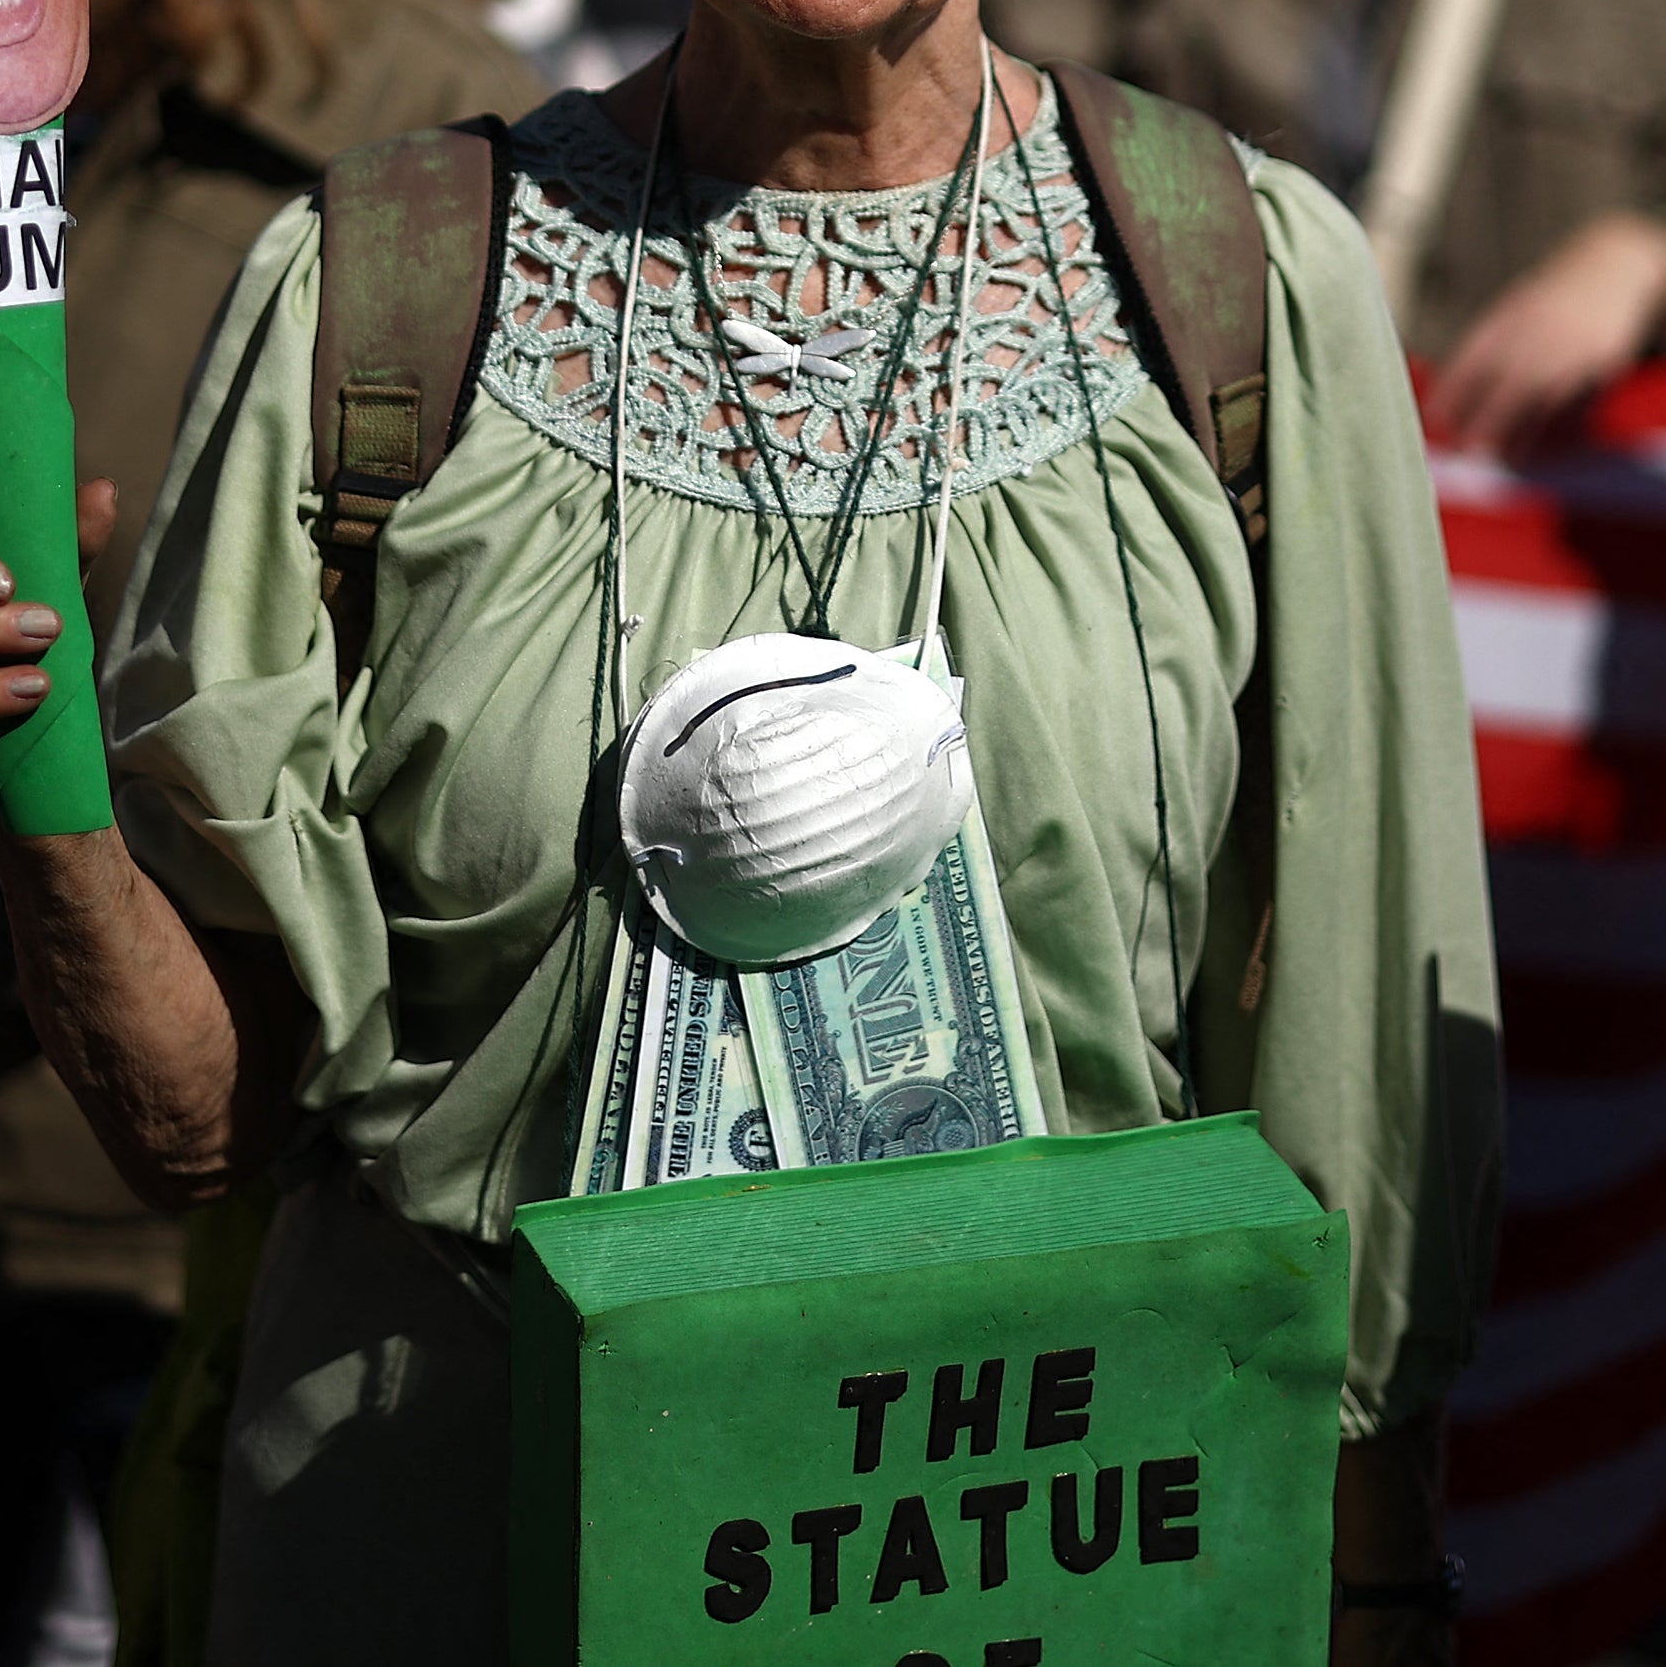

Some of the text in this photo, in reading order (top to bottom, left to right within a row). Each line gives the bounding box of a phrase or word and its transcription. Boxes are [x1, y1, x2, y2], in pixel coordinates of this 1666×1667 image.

[910, 907, 943, 1022] IN GOD WE TRUST
[653, 1002, 679, 1122] FEDERAL
[676, 1019, 708, 1117] UNITED
[978, 1005, 1000, 1042] OF
[668, 1120, 695, 1177] THE
[837, 1347, 1097, 1474] THE
[703, 1454, 1201, 1625] STATUE
